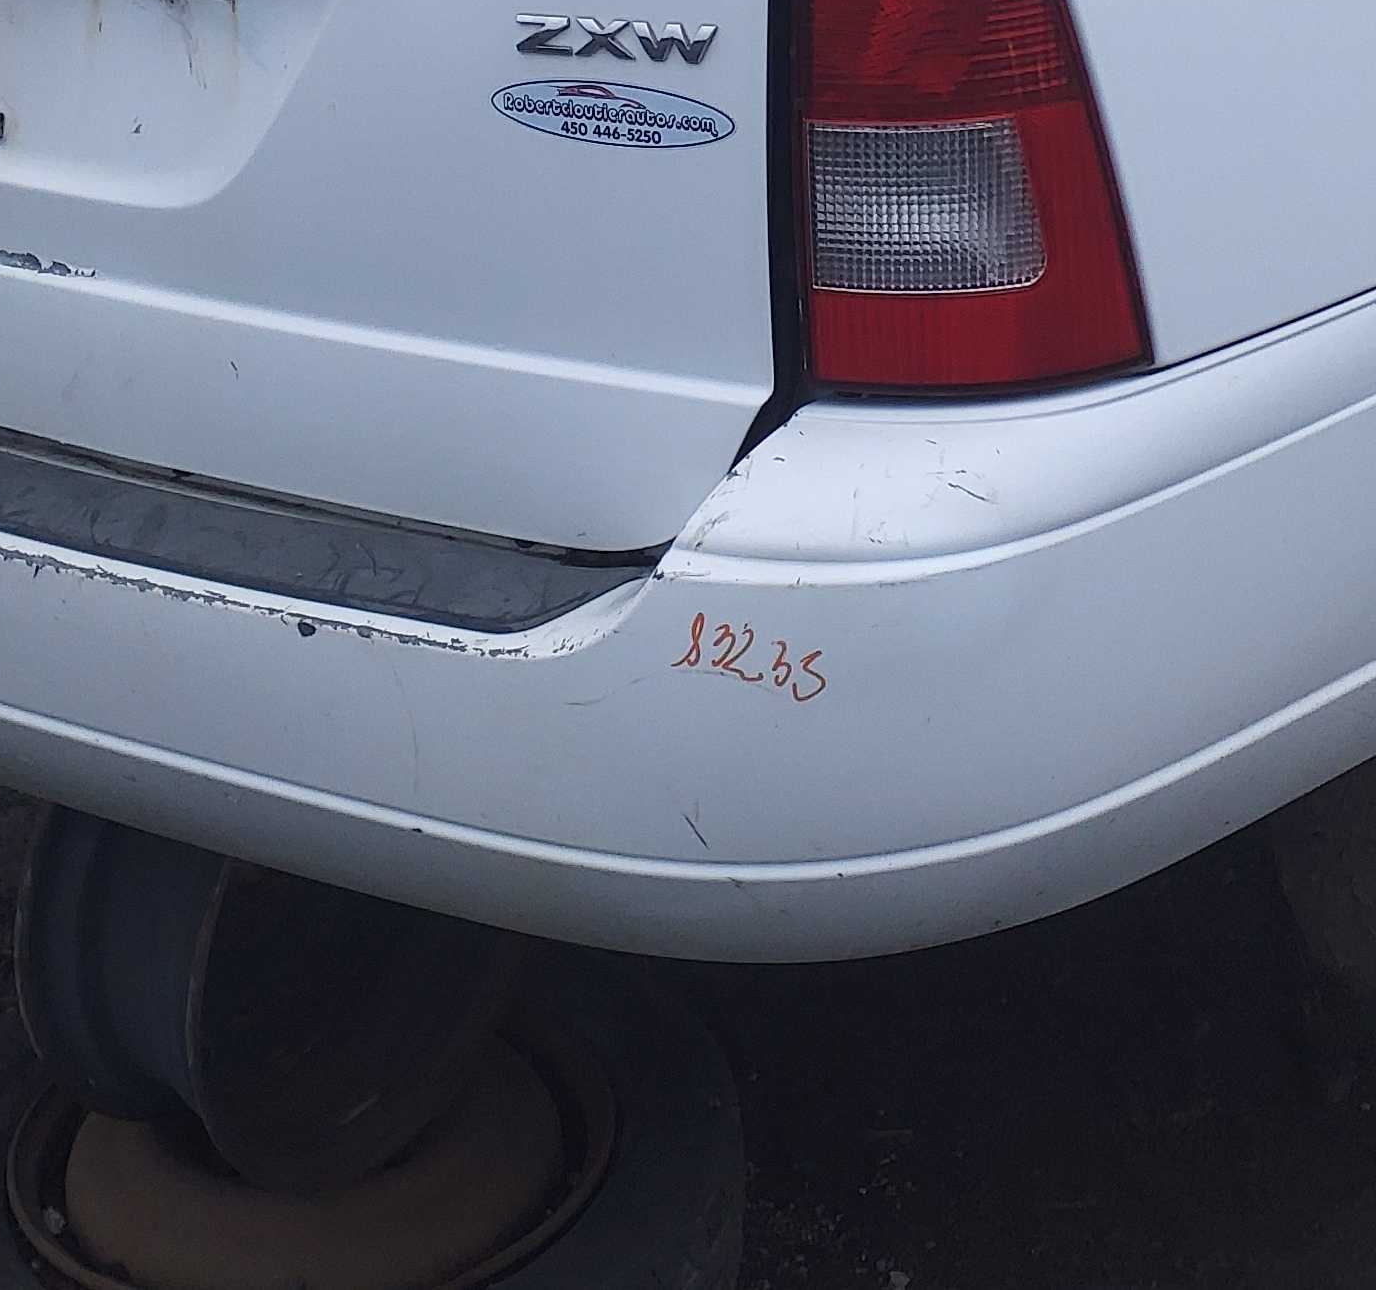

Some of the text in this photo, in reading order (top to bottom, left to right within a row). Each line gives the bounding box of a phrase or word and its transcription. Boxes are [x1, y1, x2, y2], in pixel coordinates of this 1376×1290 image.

[515, 13, 718, 65] ZXW
[560, 121, 662, 144] 450 446-5250
